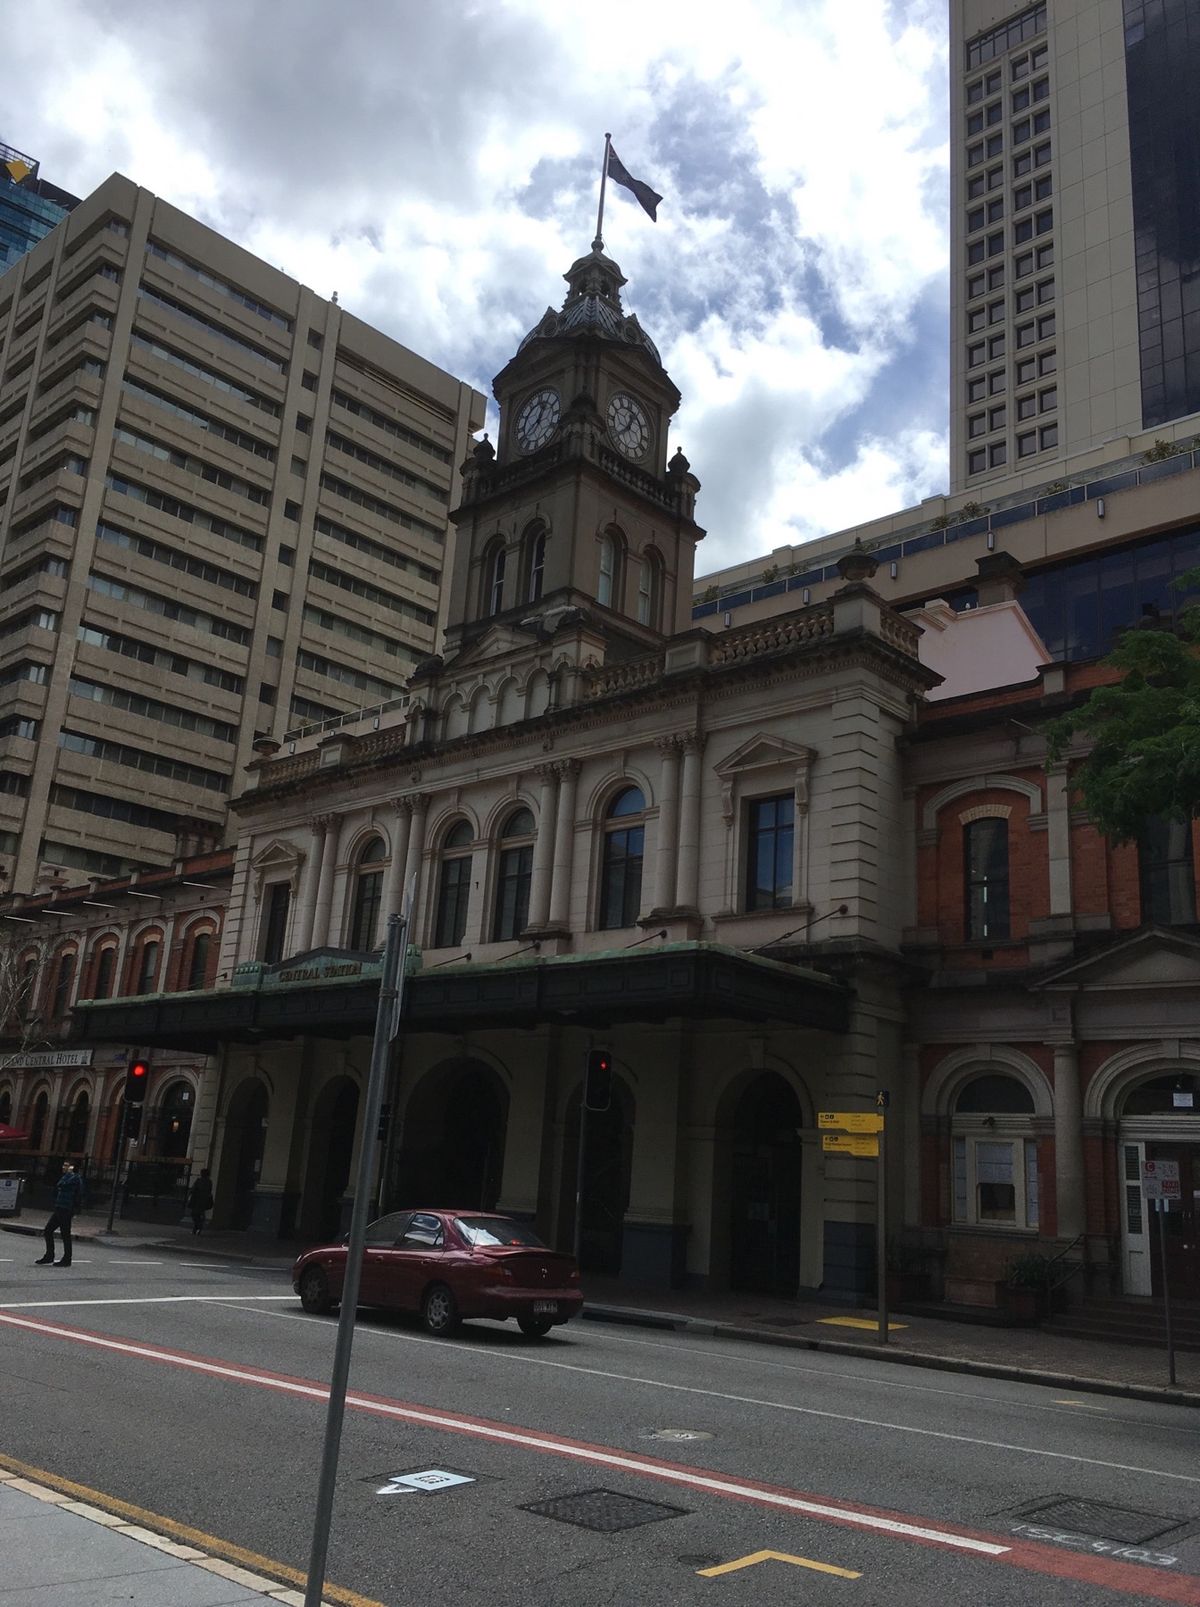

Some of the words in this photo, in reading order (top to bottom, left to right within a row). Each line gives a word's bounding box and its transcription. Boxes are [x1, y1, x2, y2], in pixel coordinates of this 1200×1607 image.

[279, 968, 320, 983] CENTRAL
[25, 1055, 54, 1066] CENTRAL
[56, 1053, 78, 1064] HOTEL
